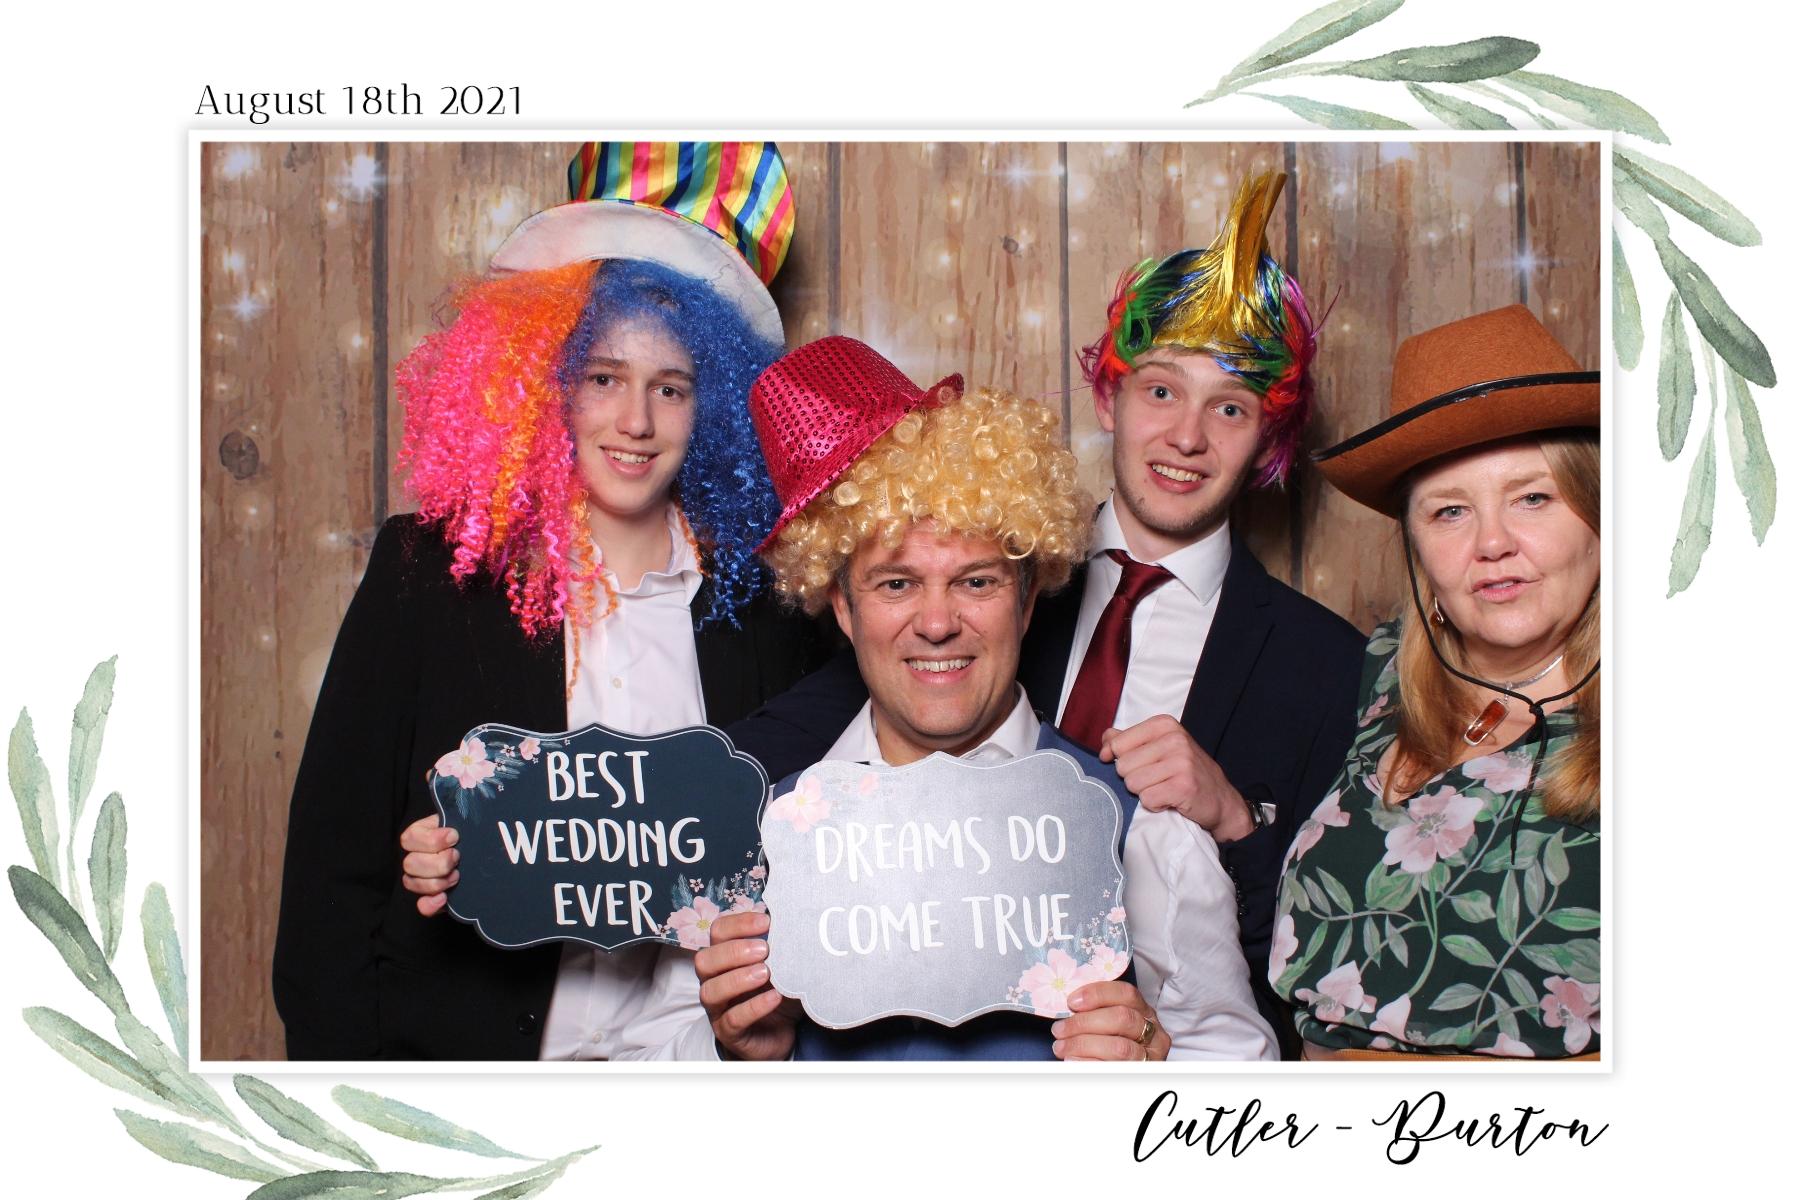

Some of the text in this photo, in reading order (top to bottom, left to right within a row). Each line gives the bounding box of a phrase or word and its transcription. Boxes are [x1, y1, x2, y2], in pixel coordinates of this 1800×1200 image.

[547, 750, 649, 808] BEST
[498, 817, 705, 868] WEDDING
[815, 814, 1066, 882] DREAMS DO
[554, 880, 660, 935] EVER
[819, 893, 1074, 957] COME TRUE
